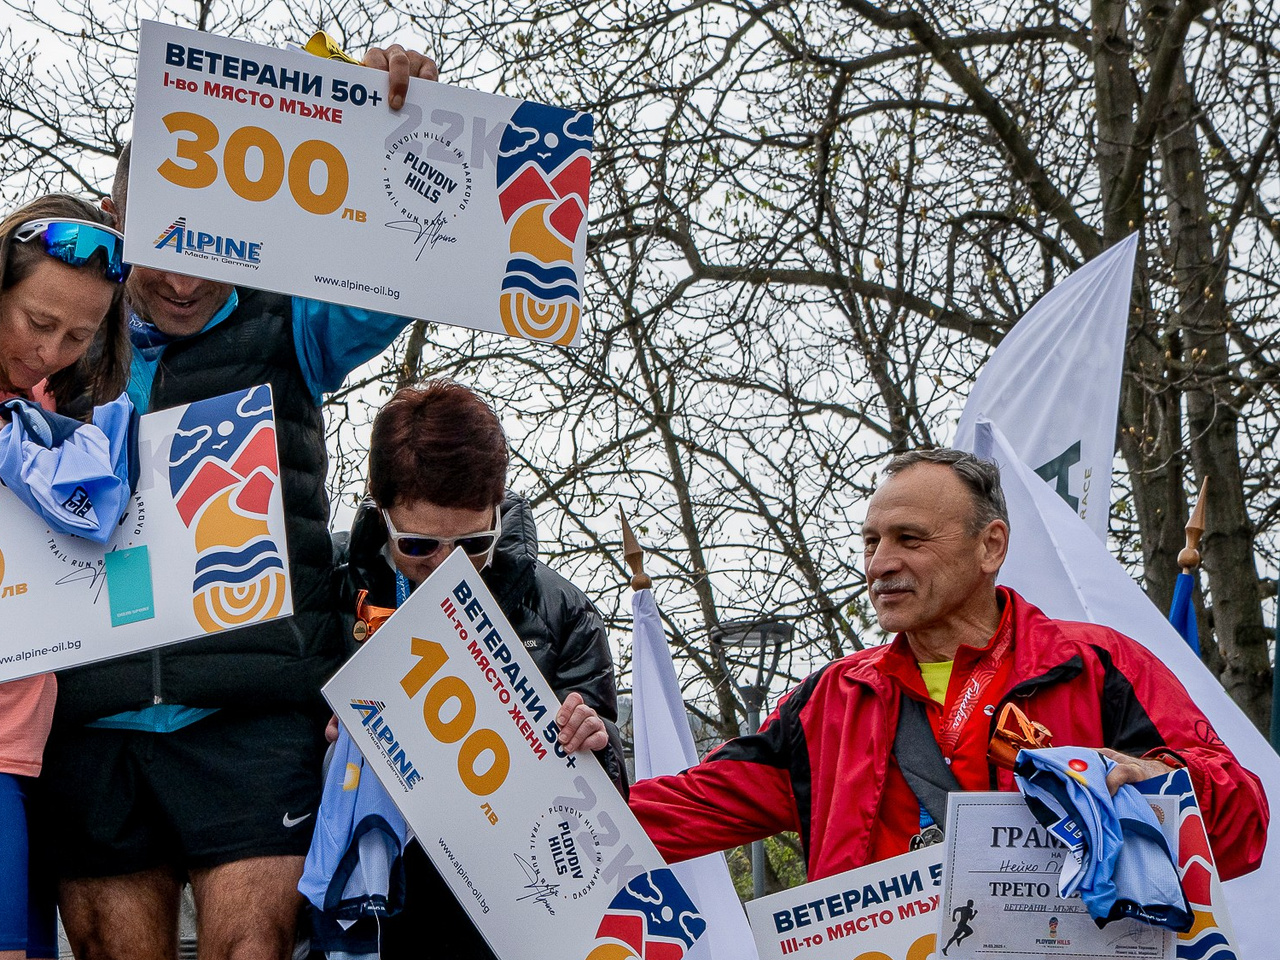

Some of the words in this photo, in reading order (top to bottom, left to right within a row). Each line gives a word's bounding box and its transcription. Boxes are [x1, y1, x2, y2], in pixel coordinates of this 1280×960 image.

[165, 42, 322, 97] ВЕТЕРАНИ
[331, 79, 382, 106] 50+
[204, 80, 274, 109] МЯСТО
[280, 97, 343, 124] МЪЖЕ
[386, 132, 418, 160] PLOVDIV
[424, 132, 451, 147] HILLS
[157, 111, 349, 215] 300
[341, 208, 367, 223] лв
[403, 151, 457, 194] PLOVDIV
[383, 178, 398, 207] TRAIL
[404, 172, 441, 204] HILLS
[459, 162, 472, 210] MARKOVO
[153, 219, 262, 265] ALPINE
[185, 250, 208, 260] Made
[221, 258, 260, 270] Germany
[314, 275, 400, 299] www.alpine-oil.bg
[47, 538, 66, 563] TRAIL
[2, 583, 28, 598] лв
[452, 579, 548, 723] ВЕТЕРАНИ
[467, 640, 511, 704] МЯСТО
[508, 703, 548, 761] ЖЕНИ
[350, 699, 424, 790] ALPINE
[399, 636, 510, 796] 100
[480, 802, 499, 826] лв
[366, 727, 381, 750] Made
[386, 759, 409, 793] Germany
[548, 805, 583, 819] PLOVDIV
[530, 821, 541, 850] TRAIL
[558, 821, 584, 879] PLOVDIV
[584, 819, 600, 847] HILLS
[548, 836, 568, 875] HILLS
[438, 837, 490, 914] www.alpine-oil.bg
[572, 867, 601, 900] MARKOVO
[989, 882, 1050, 897] ТРЕТО
[772, 870, 923, 934] ВЕТЕРАНИ
[1004, 903, 1047, 912] ВЕТЕРАНИ
[826, 909, 894, 941] МЯСТО
